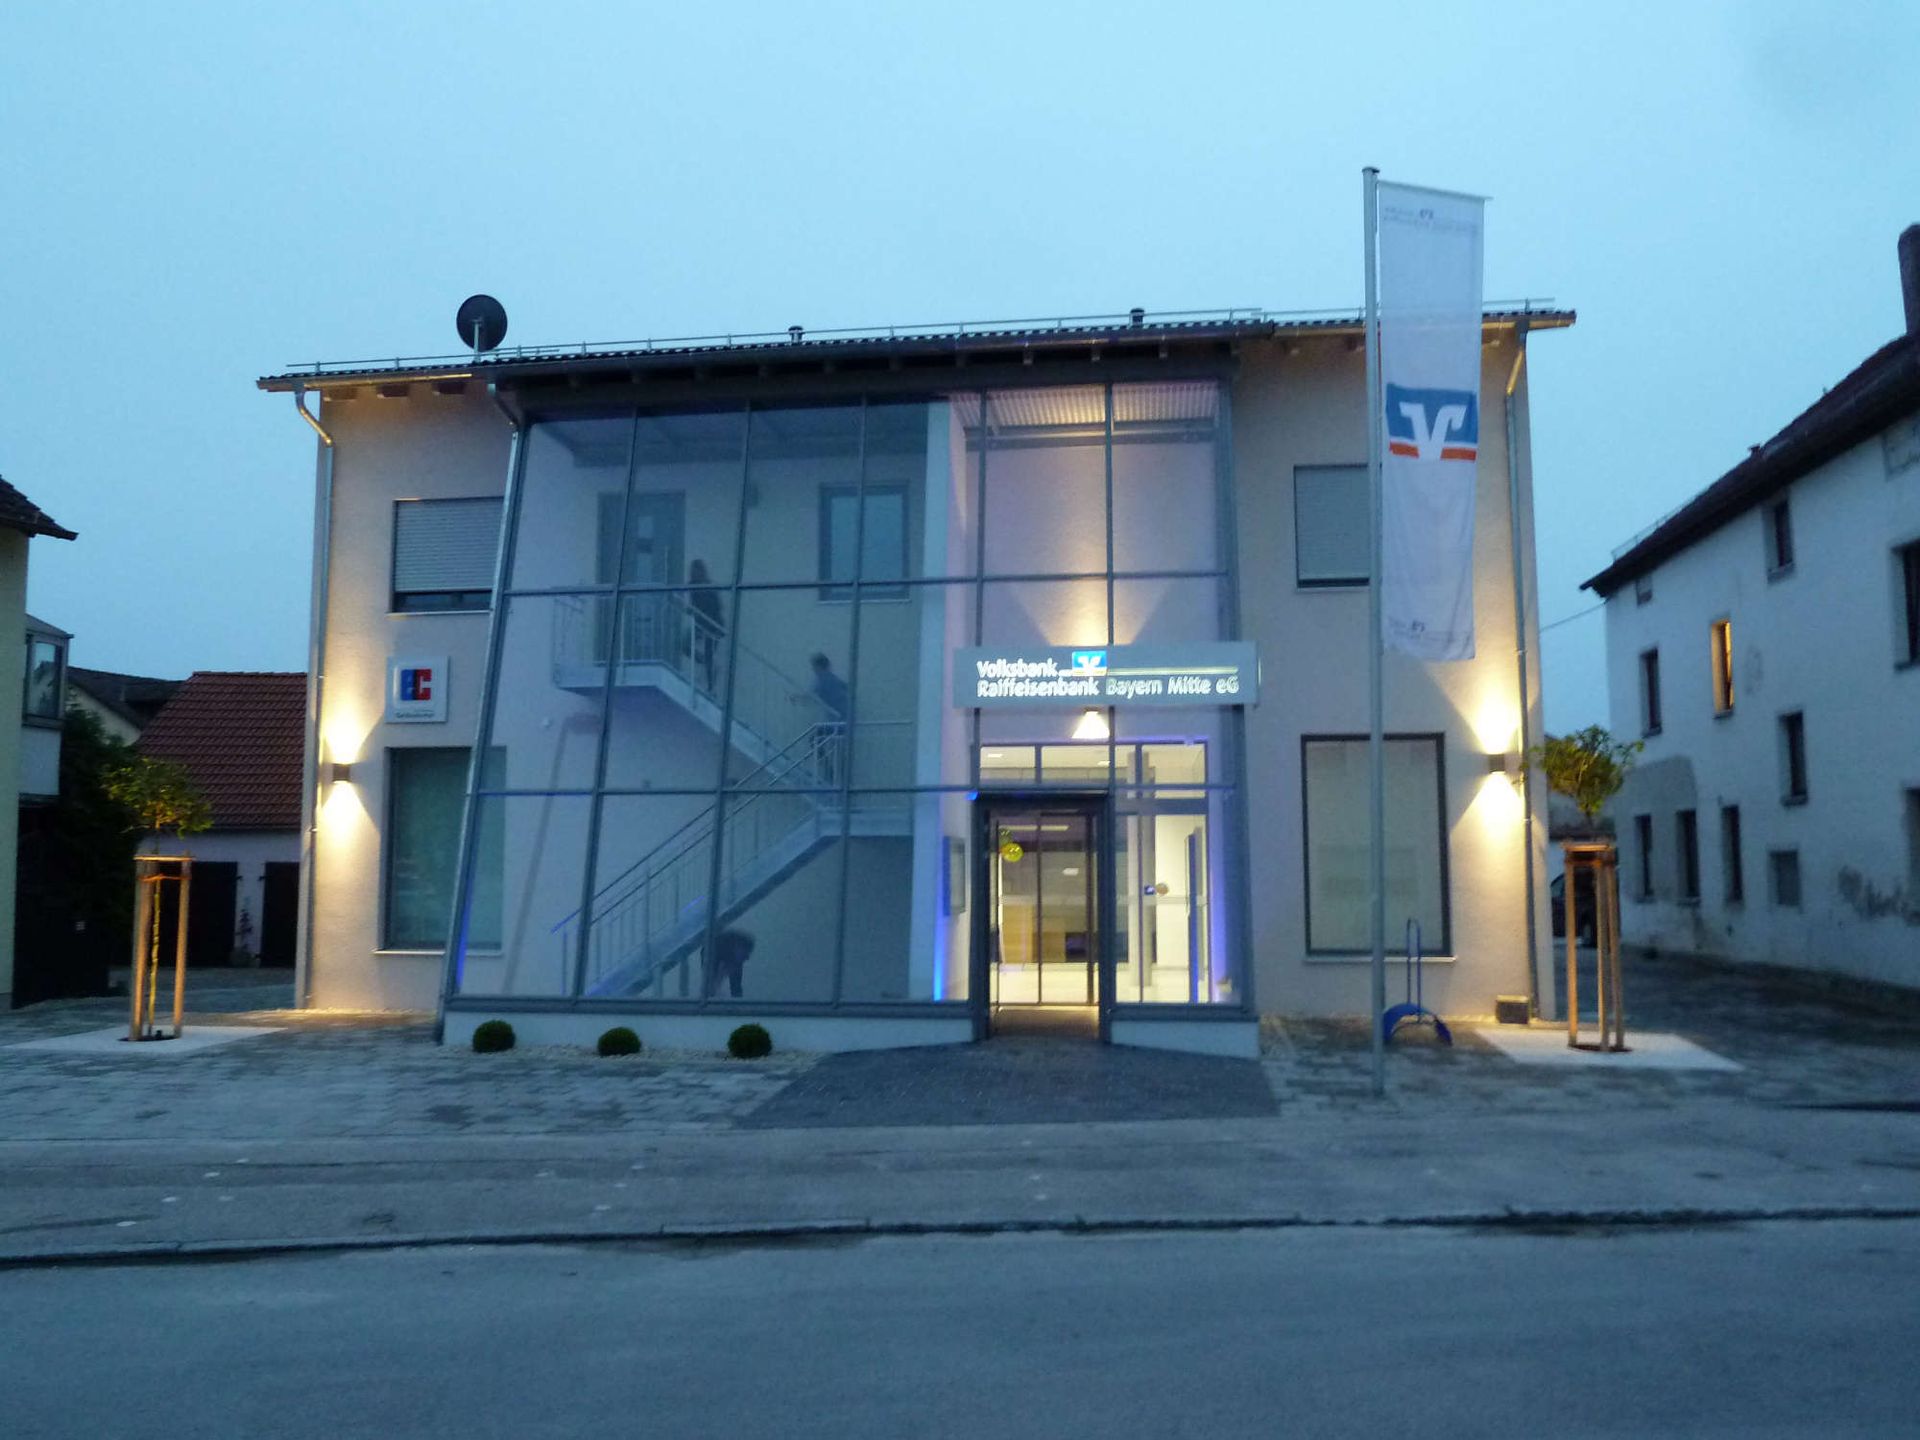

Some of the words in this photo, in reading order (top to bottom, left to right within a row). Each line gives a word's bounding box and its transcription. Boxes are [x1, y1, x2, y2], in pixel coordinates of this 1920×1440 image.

[976, 659, 1058, 678] Volksbank
[977, 678, 1100, 697] Raiffeisenbank
[1105, 677, 1162, 699] Bayern
[1167, 676, 1211, 695] Mitte
[1215, 676, 1240, 694] eG
